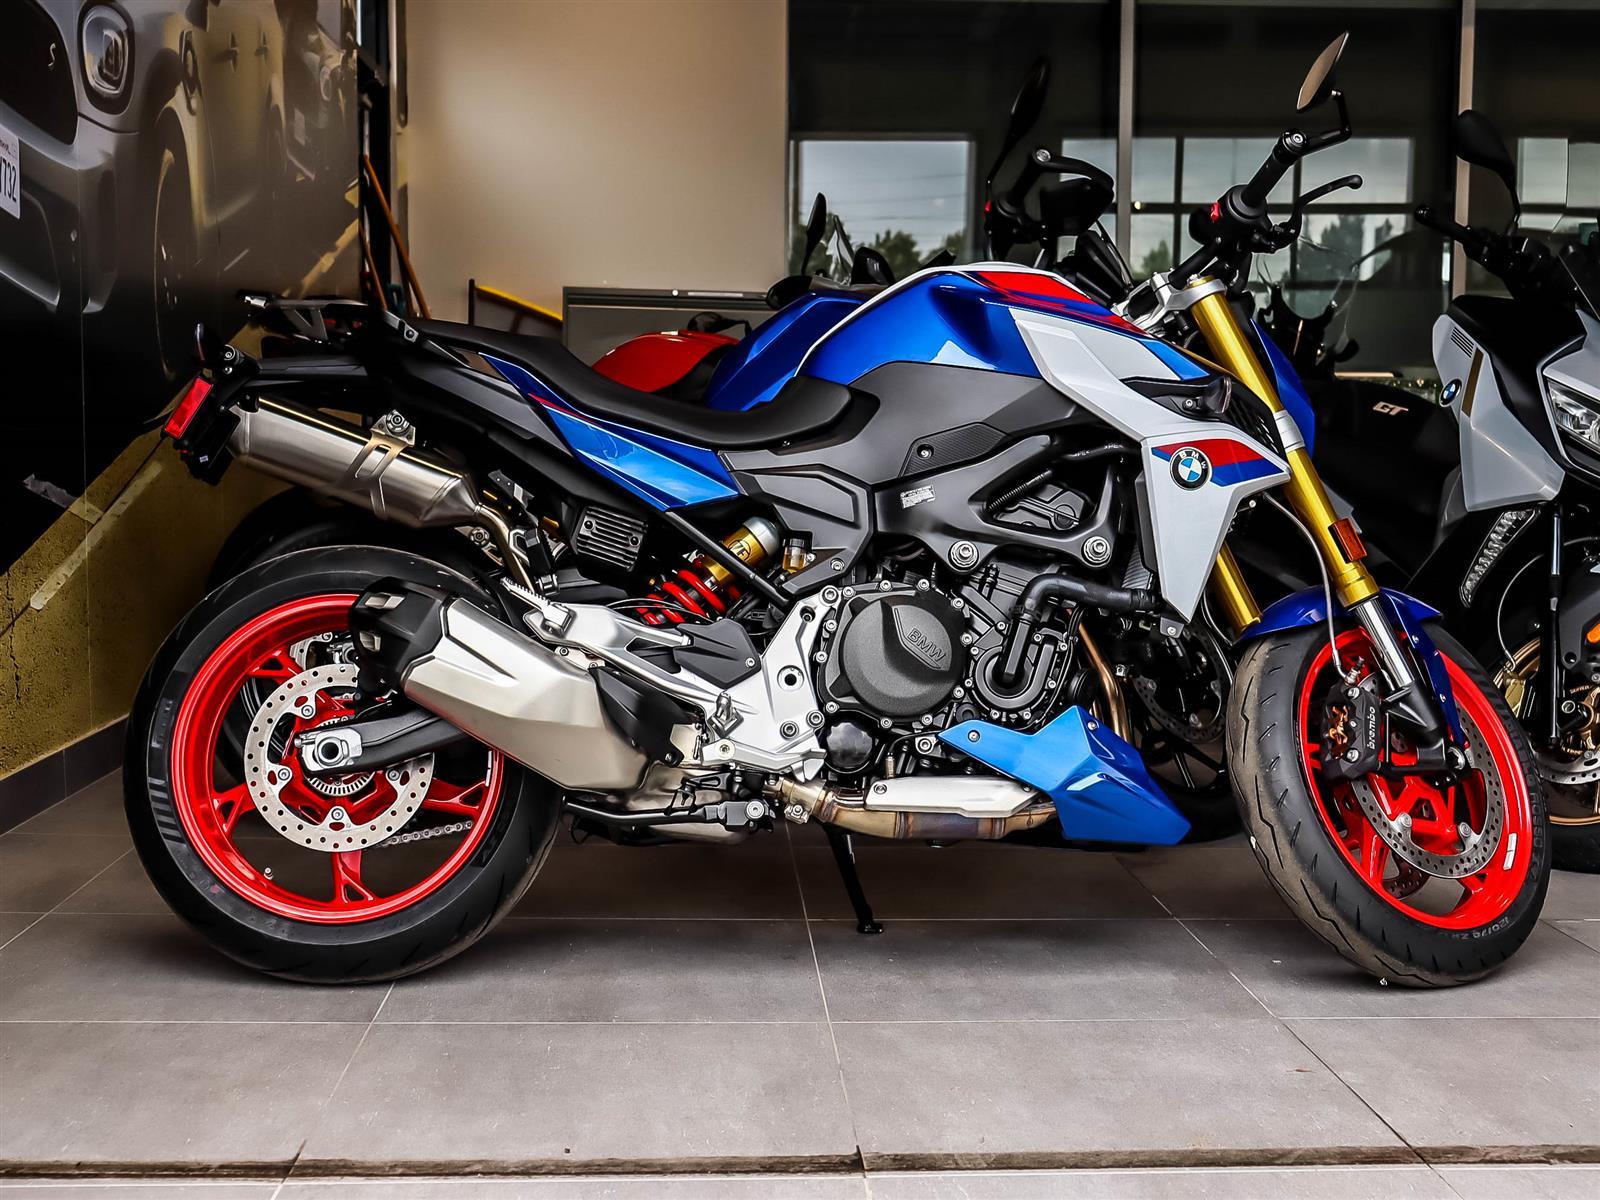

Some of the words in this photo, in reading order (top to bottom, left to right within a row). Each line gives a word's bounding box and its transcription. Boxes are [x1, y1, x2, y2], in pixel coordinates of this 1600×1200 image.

[1373, 401, 1409, 416] GT
[1179, 450, 1208, 469] BMW
[907, 627, 946, 662] BMW
[1366, 706, 1376, 750] brembo
